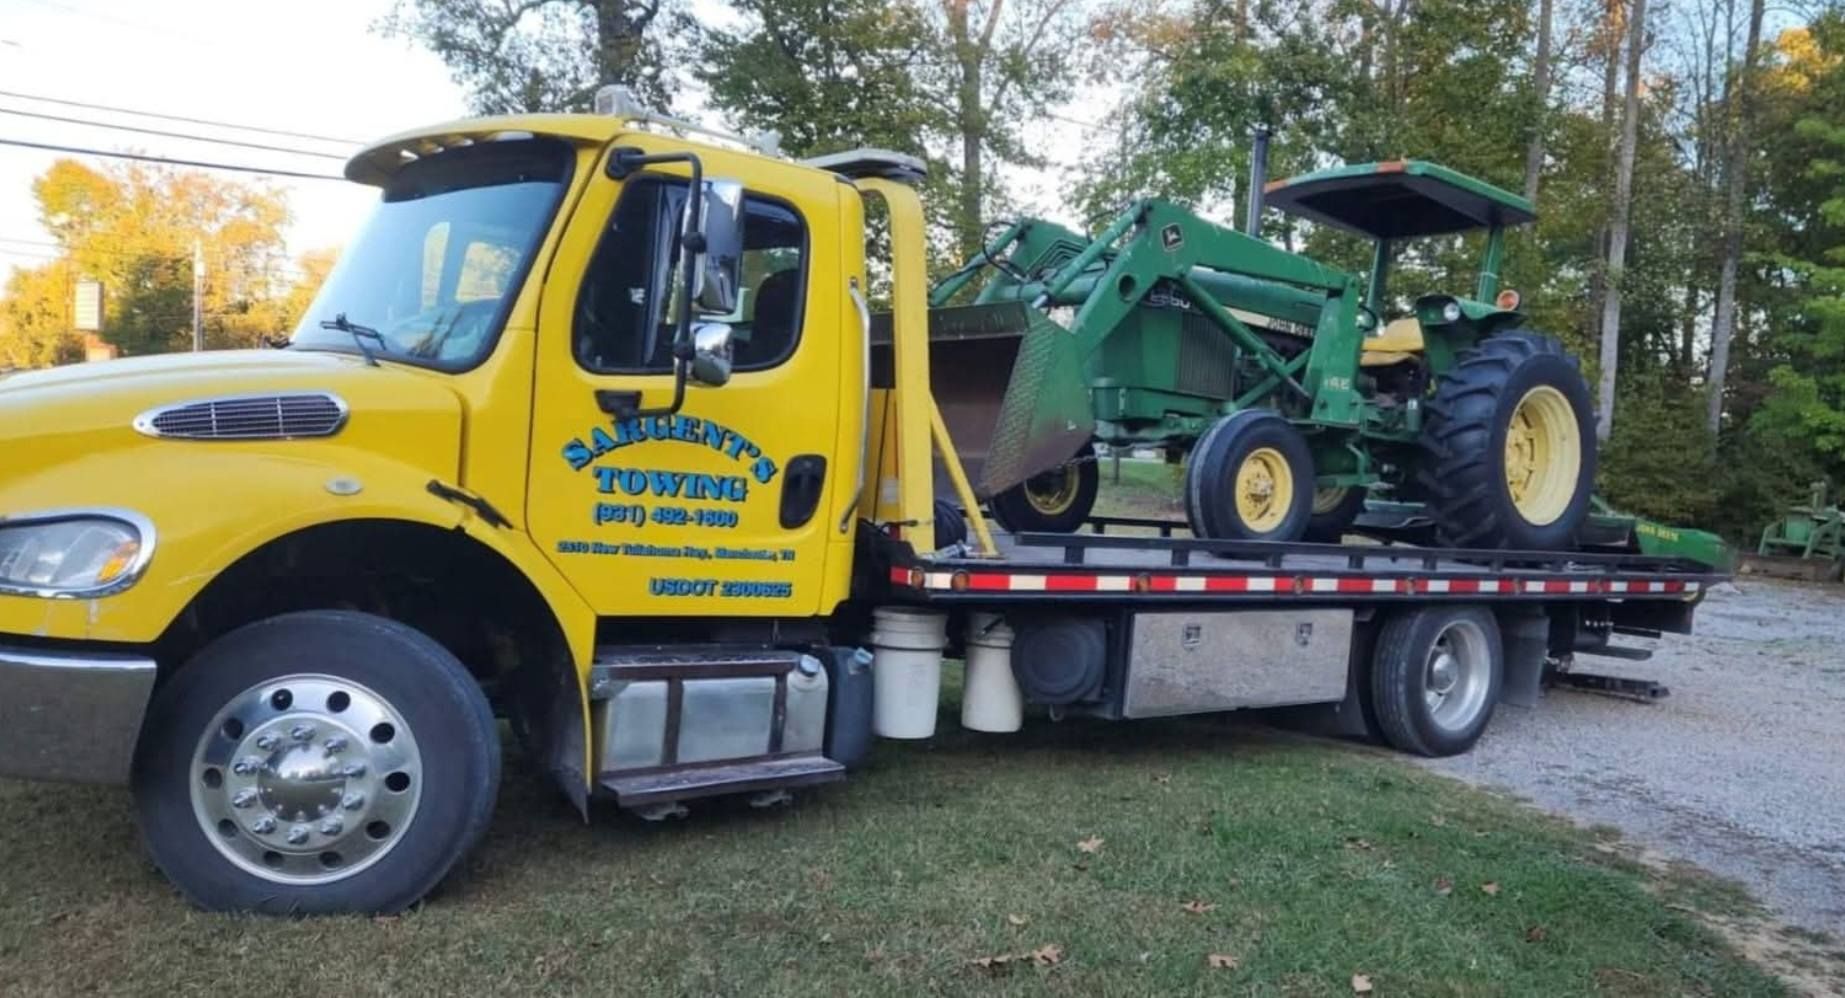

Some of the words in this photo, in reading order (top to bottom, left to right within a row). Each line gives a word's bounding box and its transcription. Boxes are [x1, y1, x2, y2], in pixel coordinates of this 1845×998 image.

[561, 413, 778, 484] SARGENT'S
[592, 466, 748, 502] TOWING
[594, 502, 647, 528] (931)
[649, 577, 719, 597] USDOT
